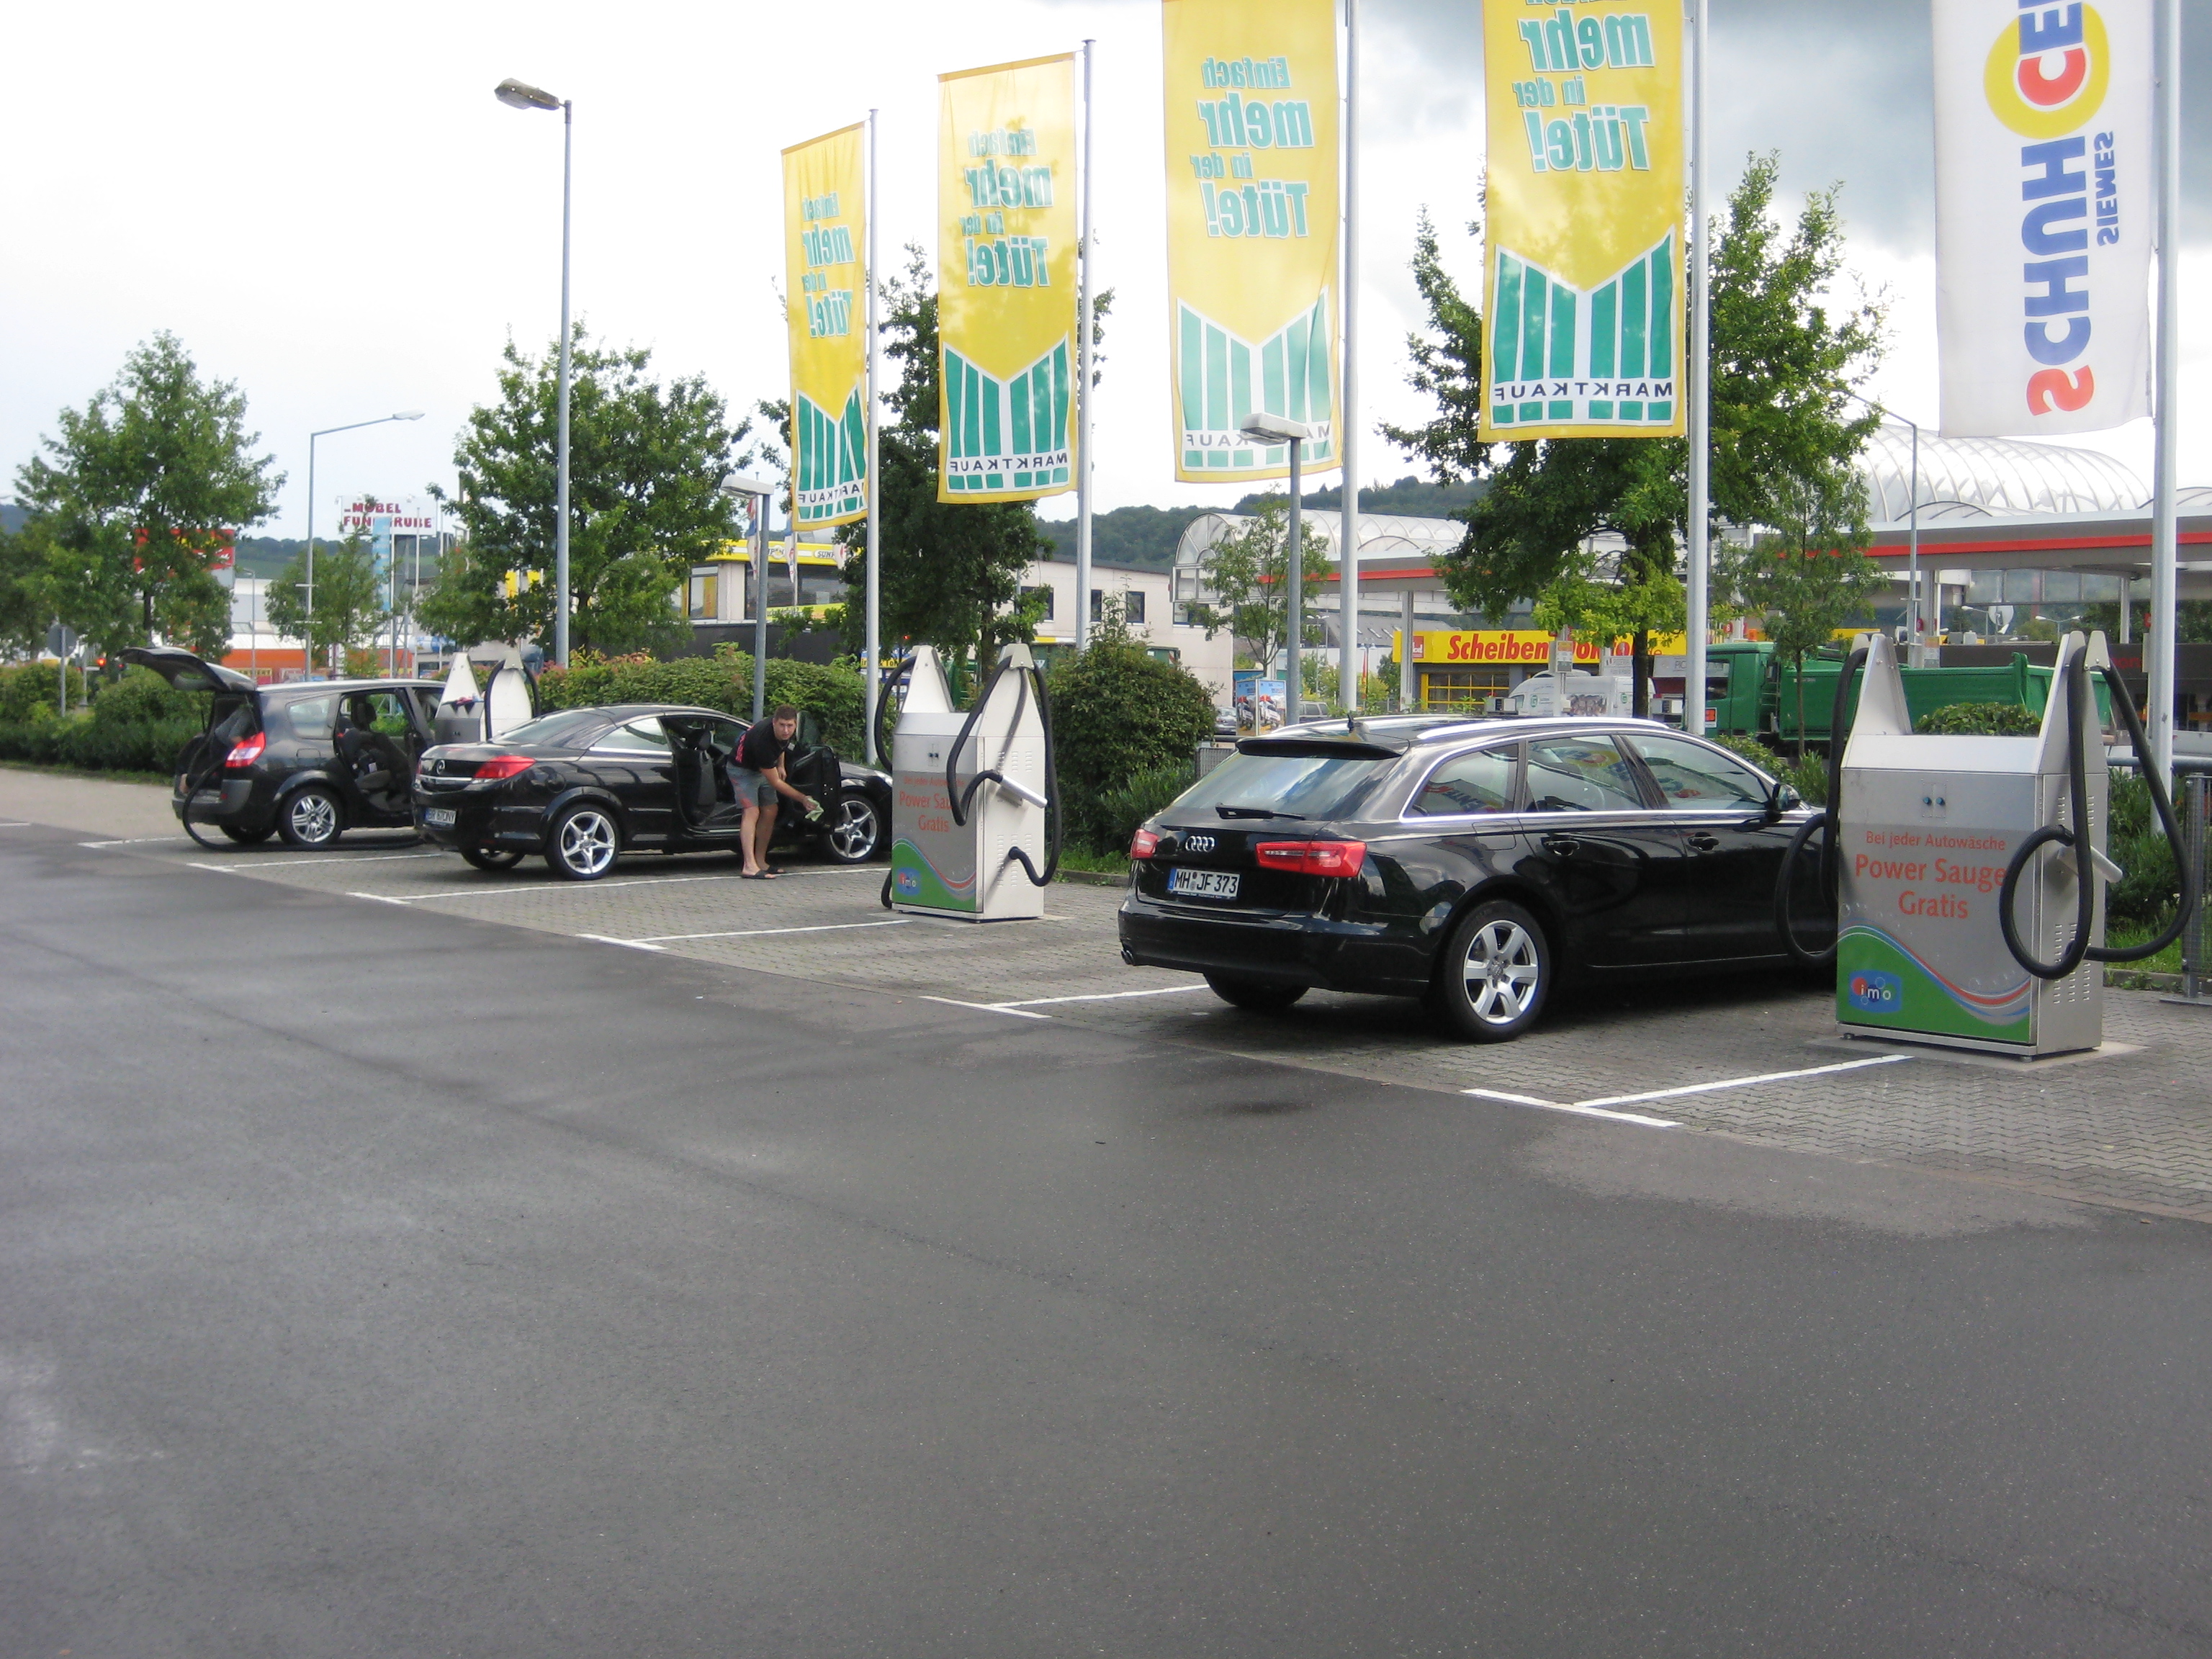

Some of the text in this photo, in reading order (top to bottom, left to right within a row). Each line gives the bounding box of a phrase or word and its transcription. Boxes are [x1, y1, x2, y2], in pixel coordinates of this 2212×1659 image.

[343, 516, 432, 528] FUNRUBE
[1447, 634, 1549, 660] Scheiben
[899, 791, 930, 808] Power
[918, 814, 950, 832] Gratis
[1866, 831, 2006, 851] Bei jeder Autowäsche
[1175, 871, 1238, 894] MH JF 373
[1855, 854, 2008, 893] Power Sauge
[1898, 891, 1969, 920] Gratis
[1861, 984, 1892, 1001] imo
